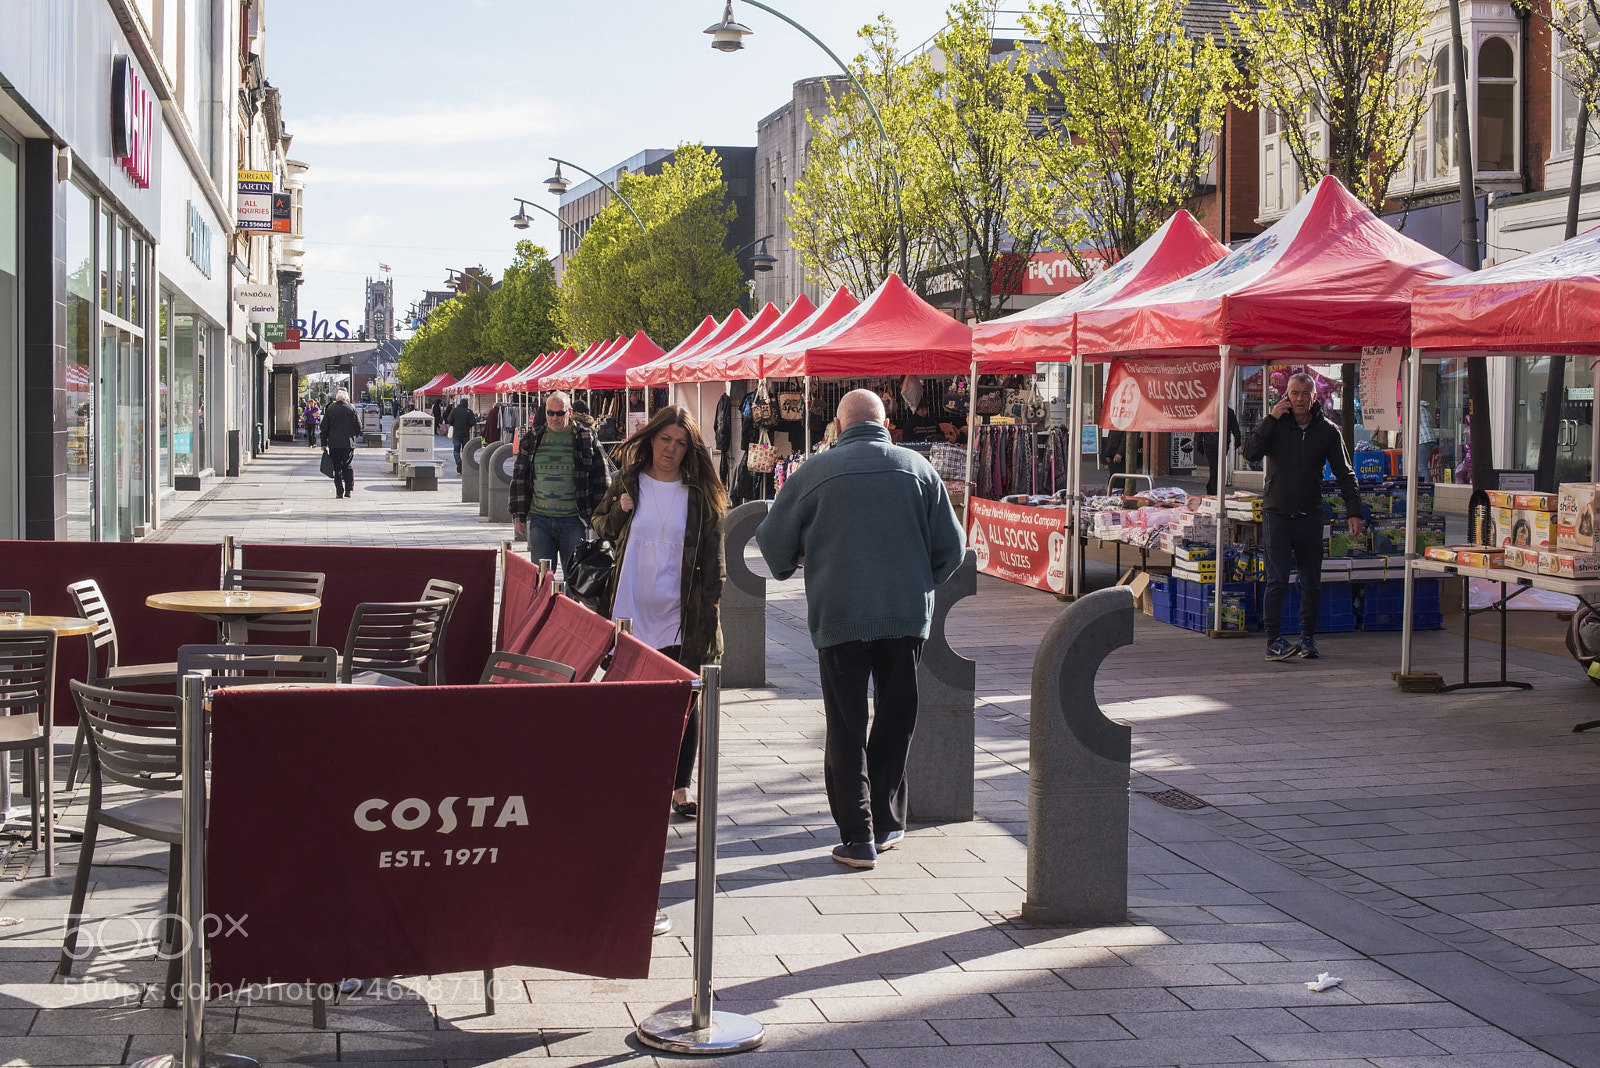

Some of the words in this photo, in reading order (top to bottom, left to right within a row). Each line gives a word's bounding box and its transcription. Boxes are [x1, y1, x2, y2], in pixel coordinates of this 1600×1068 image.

[1192, 361, 1221, 375] Compa
[1147, 379, 1165, 399] ALL
[1164, 379, 1207, 400] SOCKS
[1161, 404, 1177, 417] ALL
[1174, 404, 1198, 418] SIZES
[1360, 465, 1382, 474] QUALITY
[973, 502, 982, 515] The
[1021, 511, 1034, 525] Sock
[1033, 513, 1062, 531] Company
[989, 523, 1004, 546] ALL
[1004, 527, 1039, 552] SOCKS
[1010, 553, 1031, 569] SIZES
[353, 795, 529, 834] COSTA
[379, 850, 431, 868] EST.
[443, 847, 499, 866] 1971
